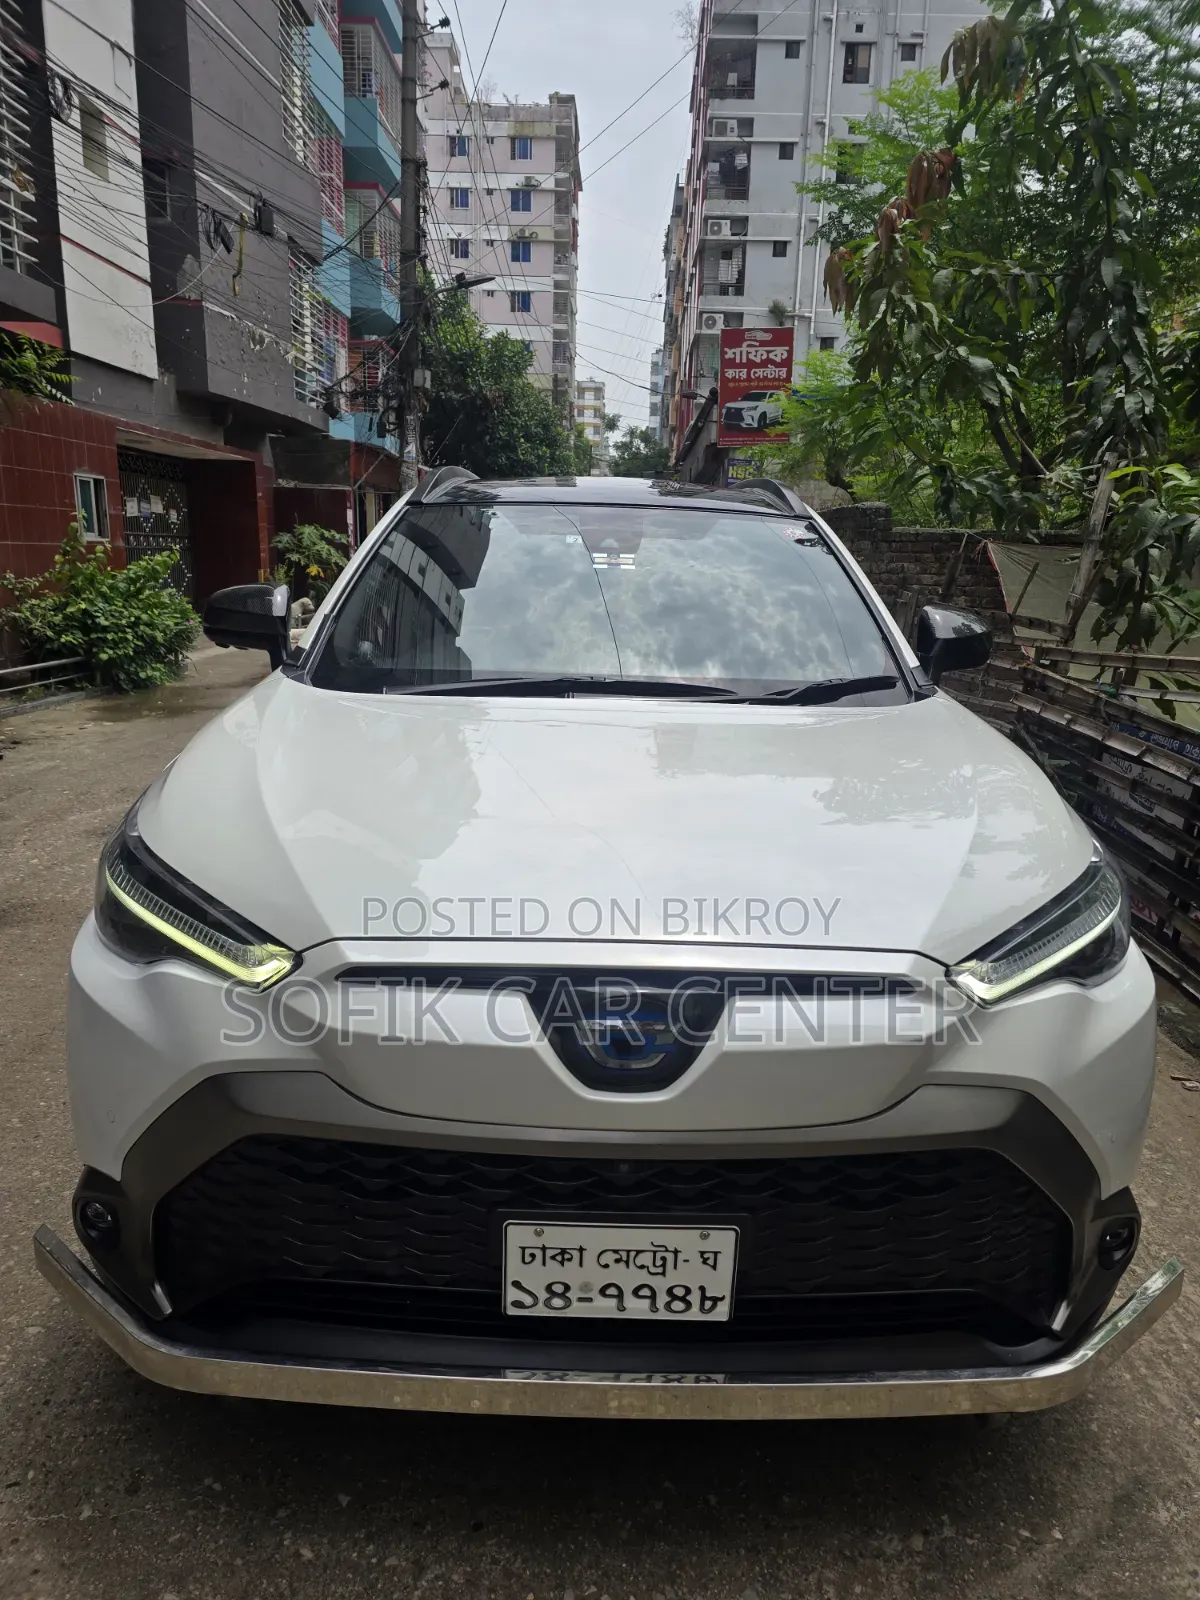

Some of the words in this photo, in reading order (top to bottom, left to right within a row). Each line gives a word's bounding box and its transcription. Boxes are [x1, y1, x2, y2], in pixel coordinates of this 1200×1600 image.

[724, 341, 789, 363] শফিক
[724, 368, 748, 380] কার
[750, 364, 788, 380] সেন্টার
[519, 1244, 587, 1268] ঢাকা
[511, 1279, 726, 1314] ১৪-৭৭৪৮
